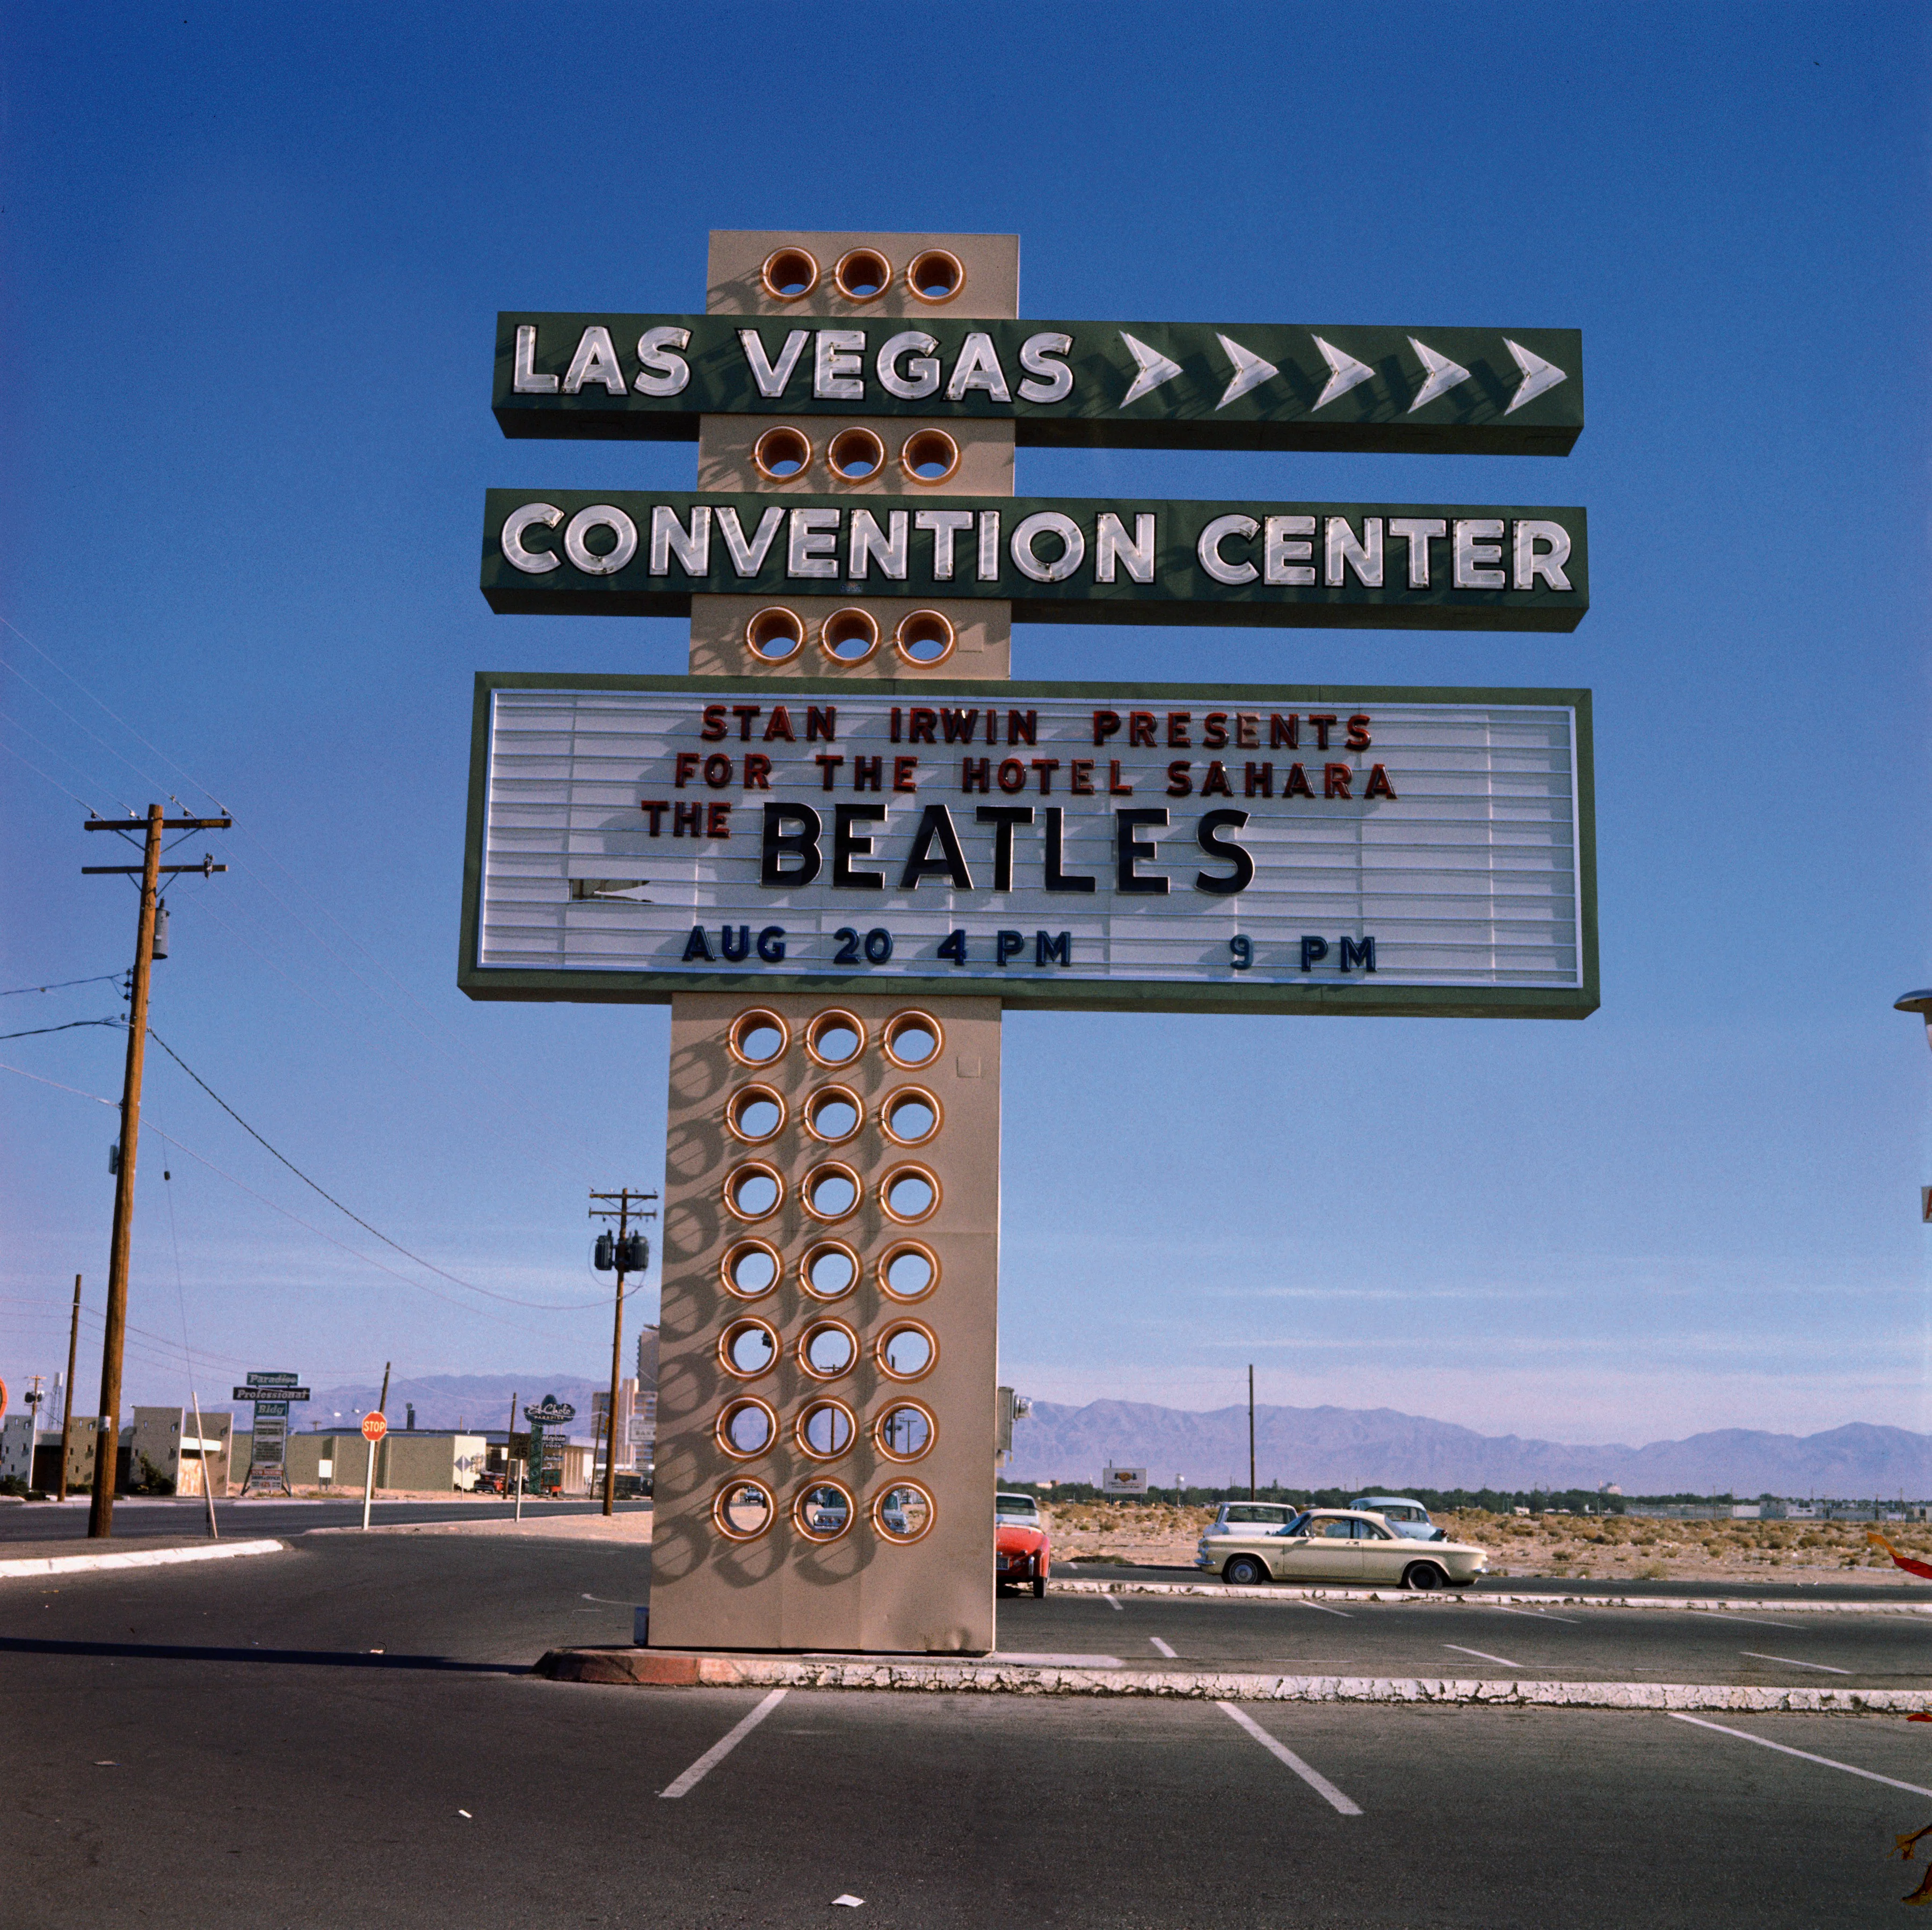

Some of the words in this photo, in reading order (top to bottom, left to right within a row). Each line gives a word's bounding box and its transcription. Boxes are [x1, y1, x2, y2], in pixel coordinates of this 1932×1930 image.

[512, 324, 693, 397] LAS
[740, 329, 1073, 404] VEGAS
[500, 502, 1156, 584] CONVENTION
[1196, 513, 1573, 592] CENTER
[700, 704, 837, 742] STAN
[890, 707, 1037, 745] IRWIN
[1093, 710, 1372, 750] PRESENTS
[674, 752, 773, 790] FOR
[815, 754, 918, 793] THE
[962, 756, 1133, 796] HOTEL
[1166, 760, 1398, 800] SAHARA
[641, 800, 731, 838] THE
[759, 801, 1255, 895] BEATLES
[681, 925, 787, 962] AUG
[833, 927, 894, 964] 20
[936, 929, 967, 966] 4
[997, 930, 1071, 967] PM
[1230, 934, 1254, 970] 9
[1301, 935, 1377, 973] PM
[236, 1389, 308, 1399] Professional
[249, 1374, 296, 1384] Paradise
[258, 1404, 285, 1415] Bldg
[364, 1420, 386, 1433] STOP
[514, 1447, 528, 1457] 45
